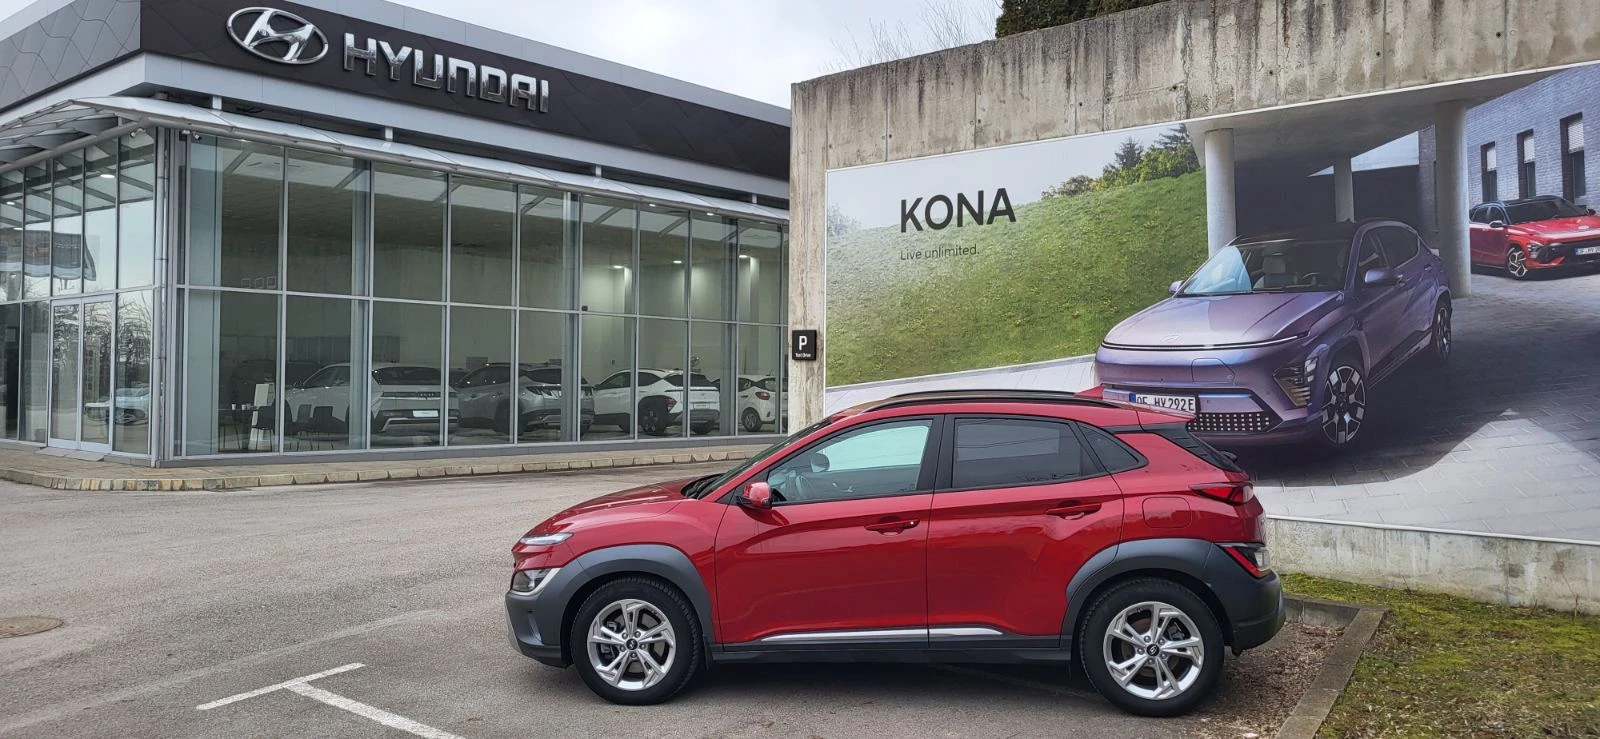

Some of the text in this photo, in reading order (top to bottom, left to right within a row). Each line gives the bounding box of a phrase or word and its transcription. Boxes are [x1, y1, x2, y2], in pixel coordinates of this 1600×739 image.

[344, 32, 549, 113] HYUNDAI
[901, 187, 1017, 233] KONA
[900, 245, 980, 261] Live unlimited.
[798, 335, 808, 351] P
